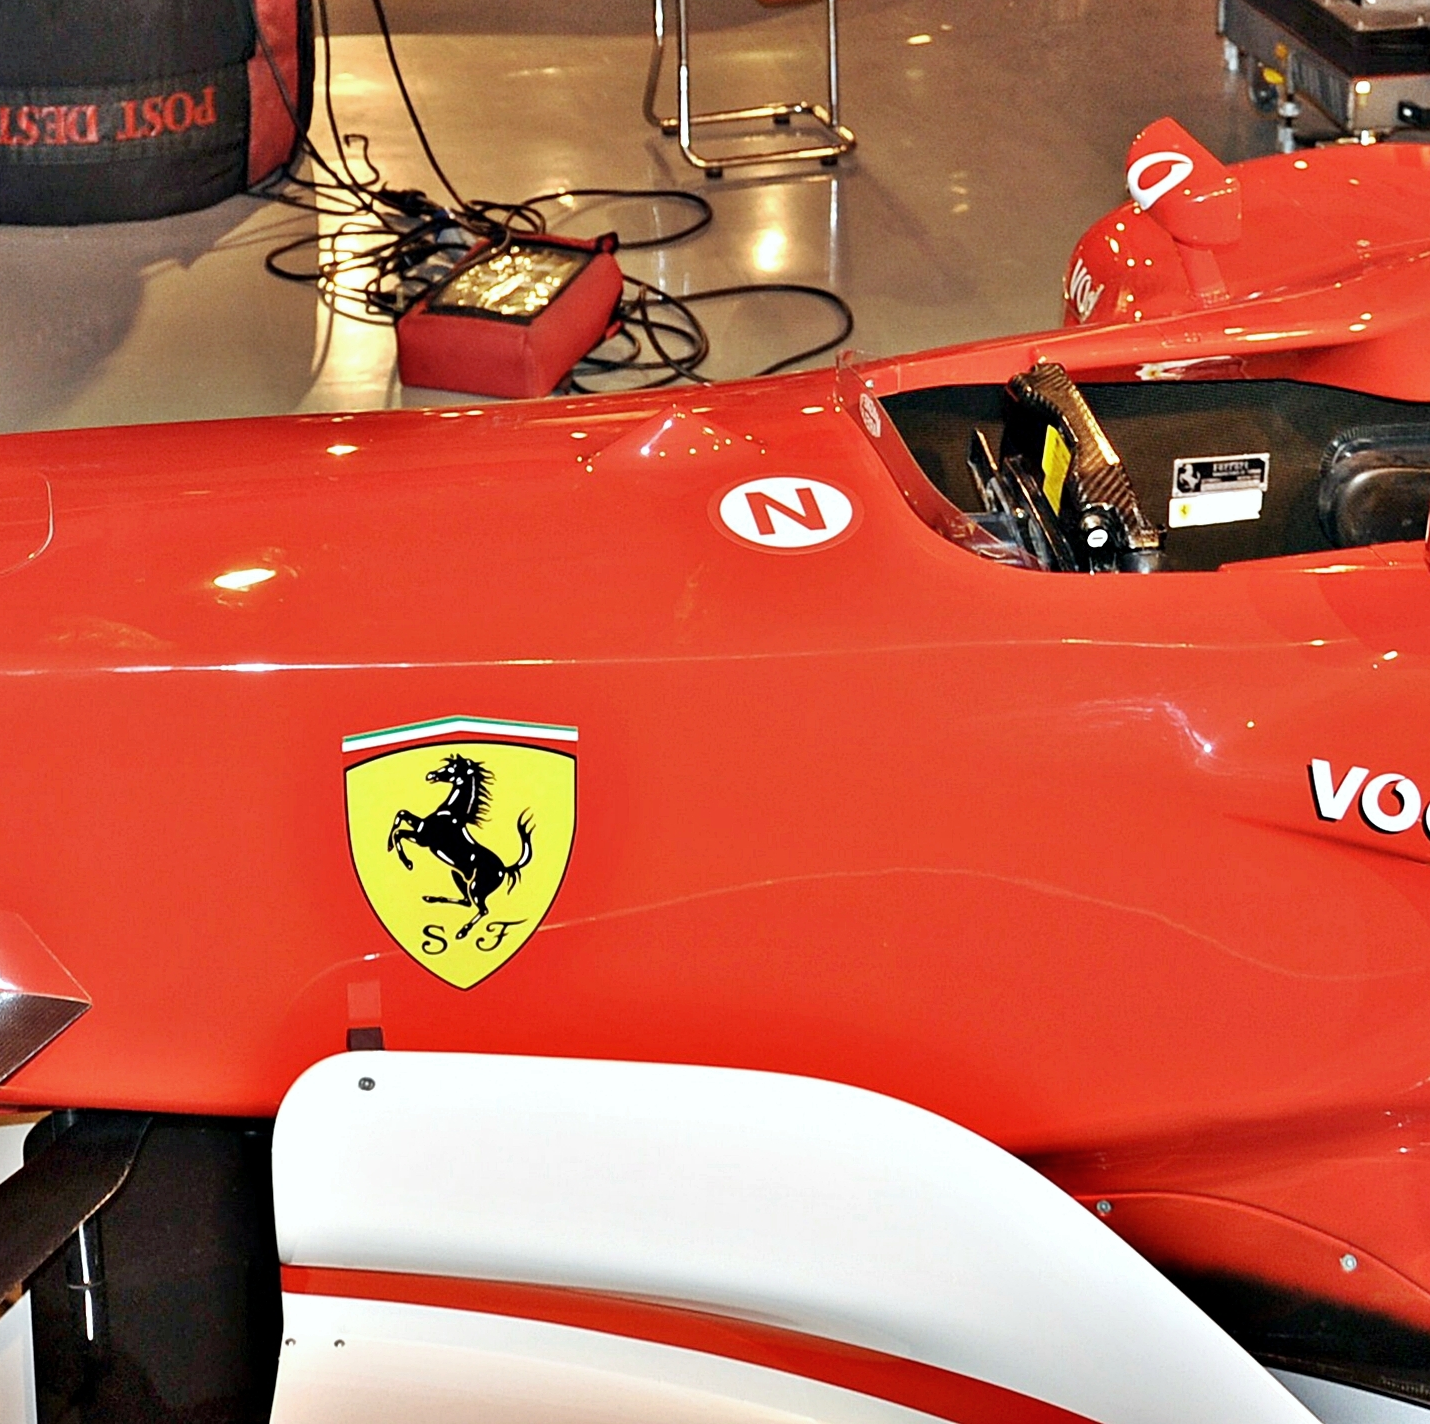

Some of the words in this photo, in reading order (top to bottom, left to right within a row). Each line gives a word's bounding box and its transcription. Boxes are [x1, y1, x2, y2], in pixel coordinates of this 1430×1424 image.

[114, 85, 217, 141] POST
[743, 486, 829, 535] N
[421, 923, 449, 956] S
[474, 918, 530, 953] F
